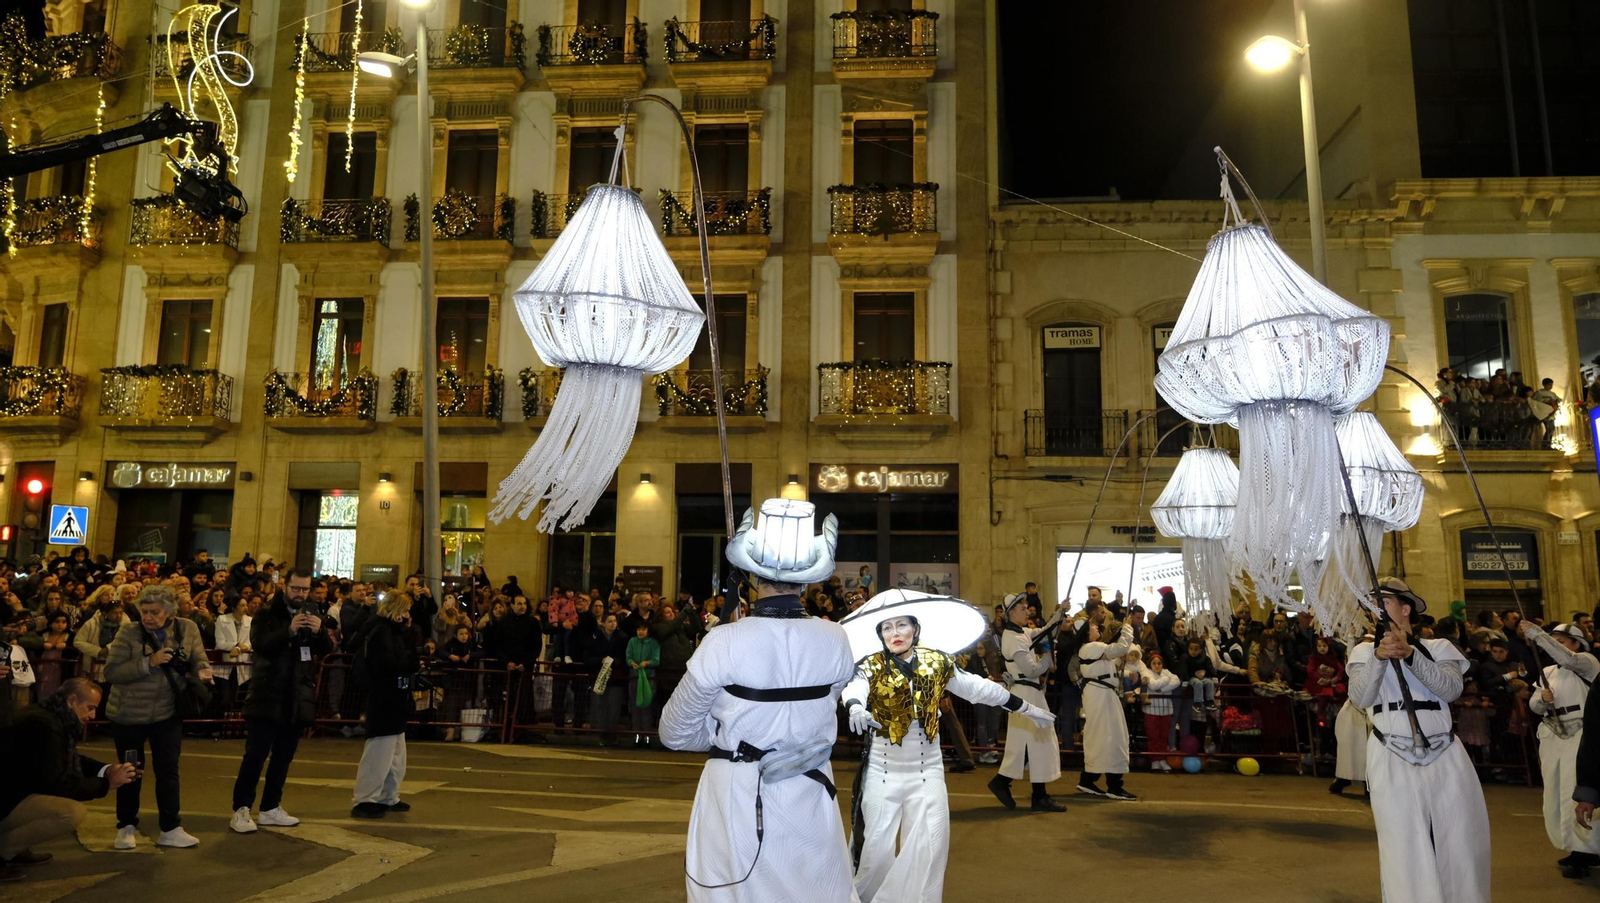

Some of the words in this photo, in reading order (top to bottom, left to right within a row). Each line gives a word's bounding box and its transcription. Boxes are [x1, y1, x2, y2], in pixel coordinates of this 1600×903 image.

[1050, 329, 1093, 338] Tramas
[145, 463, 230, 487] cajamar
[855, 466, 949, 492] cajamar
[381, 501, 389, 509] 10
